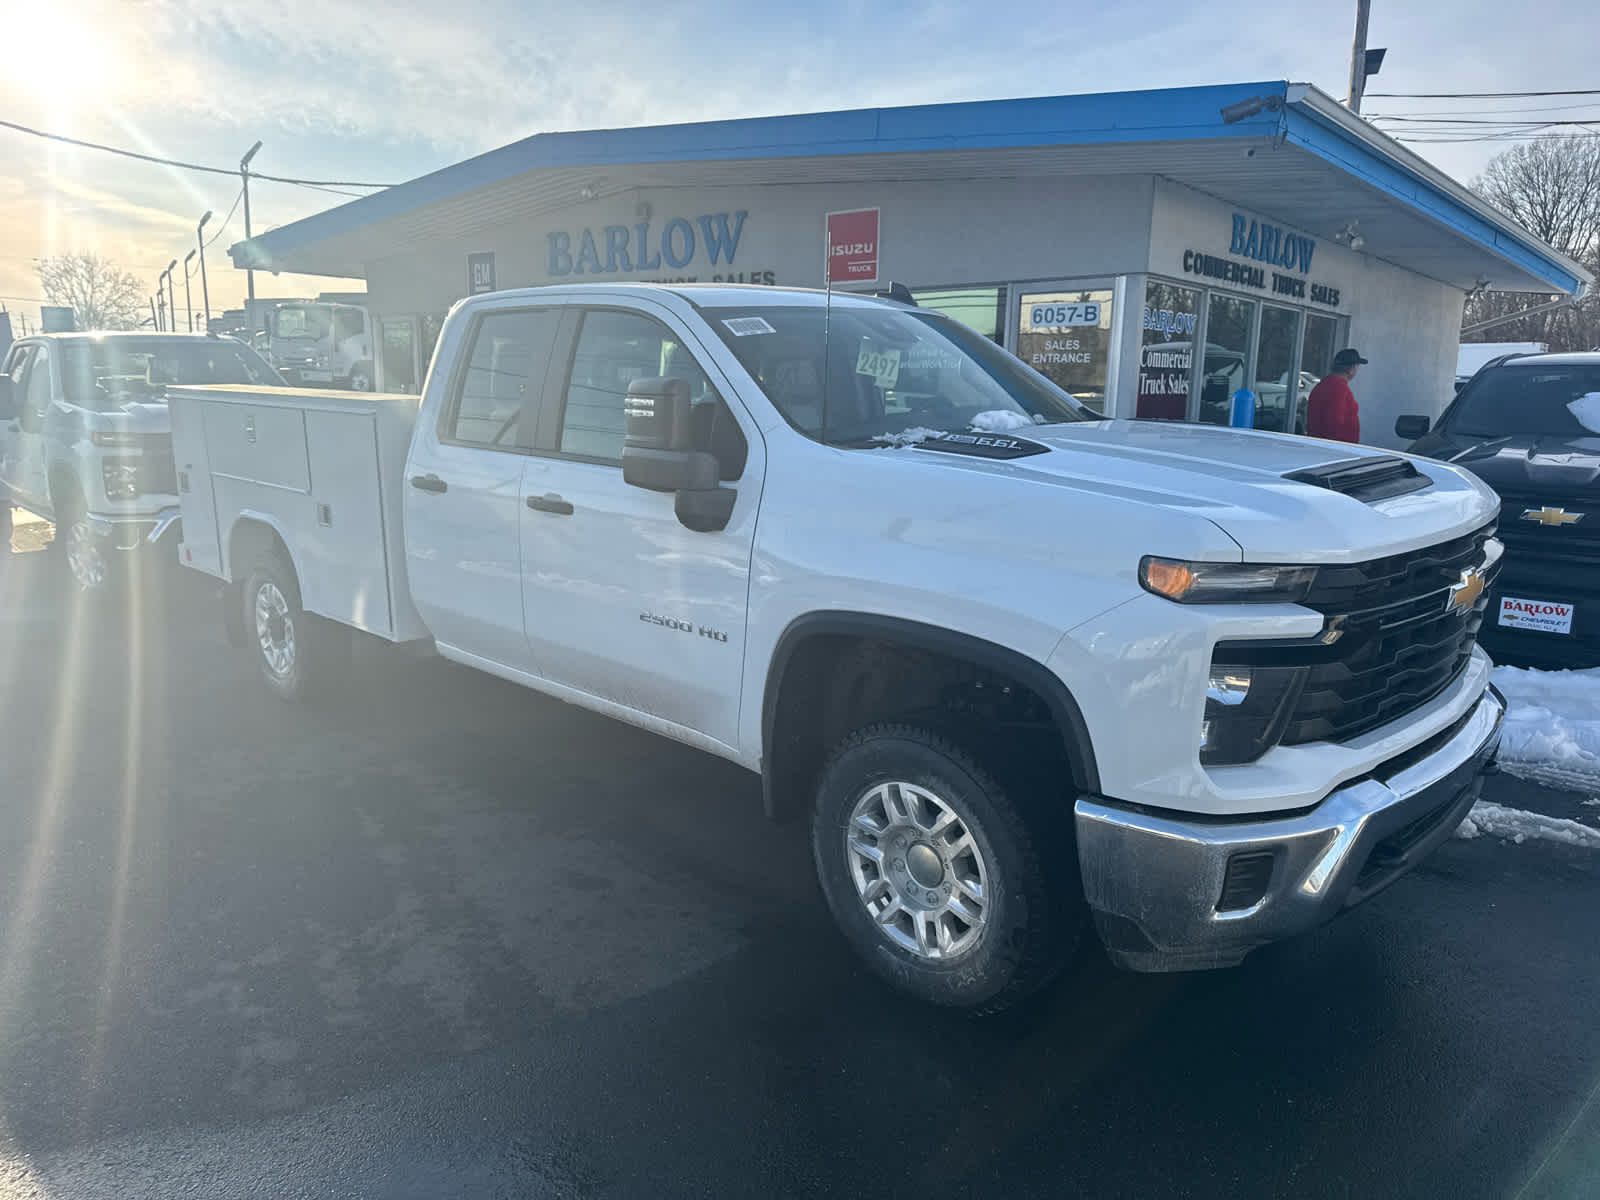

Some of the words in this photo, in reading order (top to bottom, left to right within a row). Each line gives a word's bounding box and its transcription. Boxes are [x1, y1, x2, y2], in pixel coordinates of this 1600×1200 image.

[546, 210, 749, 277] BARLOW
[832, 243, 874, 257] ISUZU
[1229, 213, 1316, 275] BARLOW
[474, 263, 491, 284] GM
[848, 264, 873, 273] TRUCK
[1183, 249, 1266, 289] COMMERCIAL
[1272, 271, 1306, 299] TRUCK
[1311, 283, 1341, 307] SALES
[1032, 305, 1098, 324] 6057-B
[1143, 307, 1197, 341] BARLOW
[1044, 340, 1081, 351] SALES
[859, 351, 898, 377] 2497
[1032, 353, 1092, 364] ENTRANCE
[1140, 345, 1193, 369] Commercial
[1140, 373, 1166, 395] Truck
[1168, 374, 1190, 395] Sales
[1503, 601, 1570, 616] BARLOW
[640, 613, 693, 633] 2500
[698, 626, 728, 643] HD
